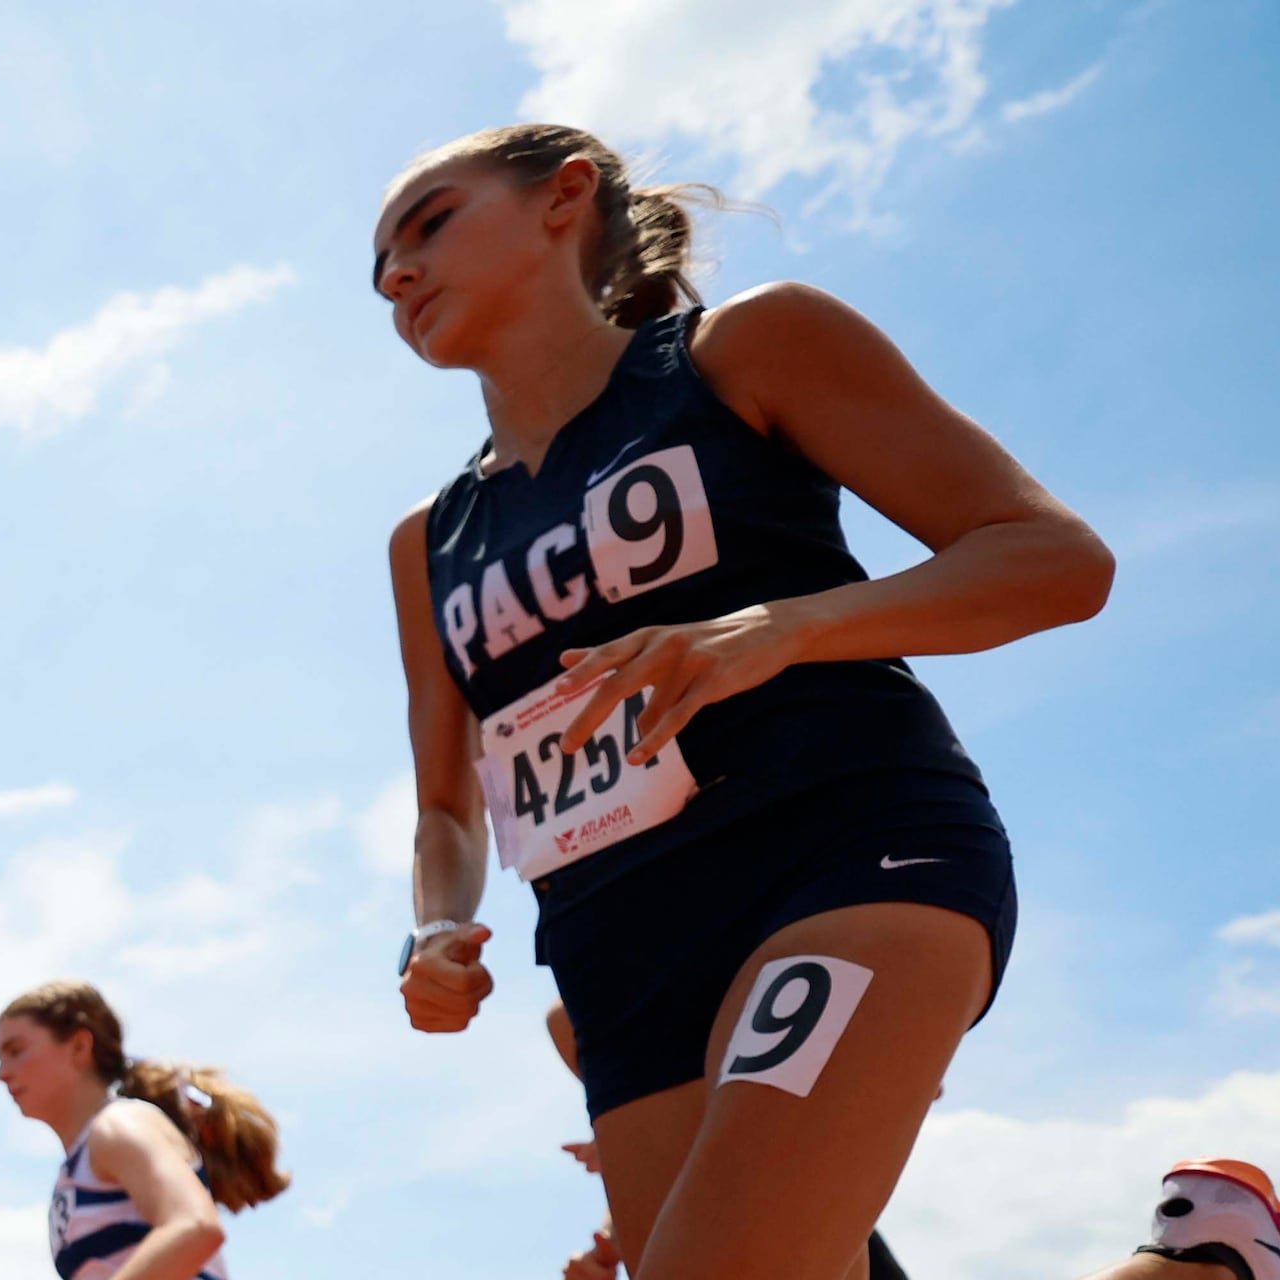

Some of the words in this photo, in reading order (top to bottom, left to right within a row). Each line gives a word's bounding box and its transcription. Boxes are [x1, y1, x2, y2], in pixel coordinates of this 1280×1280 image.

[608, 464, 684, 586] 9
[443, 511, 603, 681] PAC
[578, 804, 633, 840] ATLANTA
[728, 962, 832, 1075] 9
